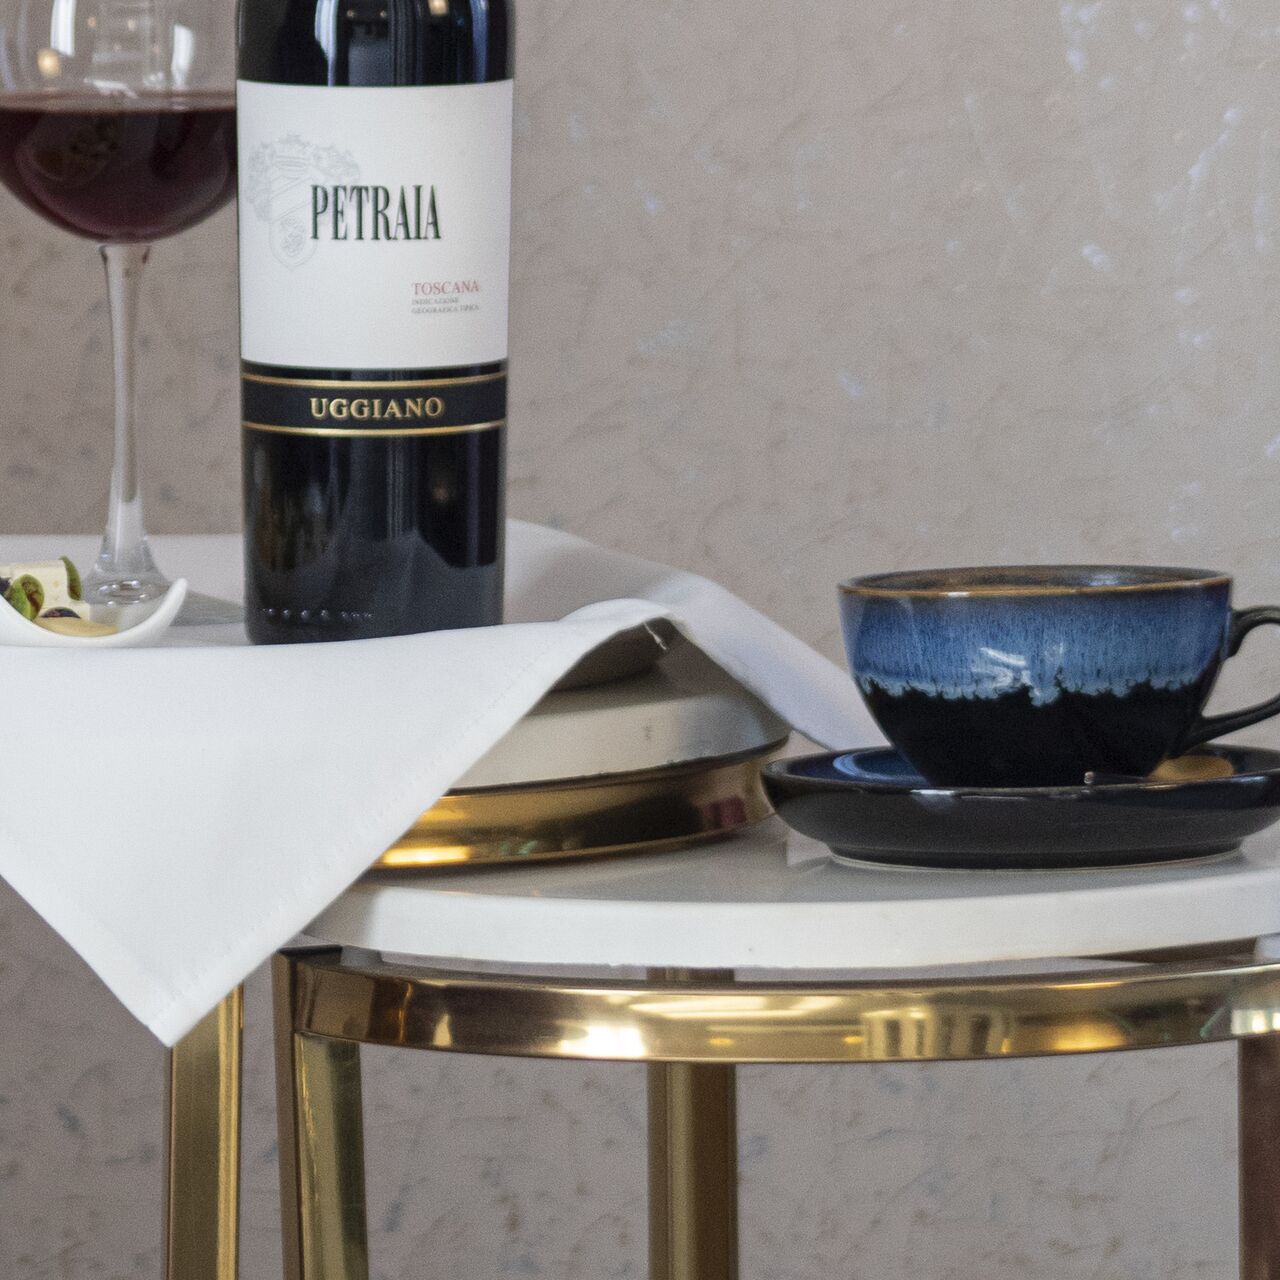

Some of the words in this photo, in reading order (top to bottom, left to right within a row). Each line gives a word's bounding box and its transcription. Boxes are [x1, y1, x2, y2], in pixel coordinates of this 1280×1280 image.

[310, 184, 442, 240] PETRAIA
[411, 280, 480, 296] TOSCANA
[309, 396, 444, 419] UGGIANO
